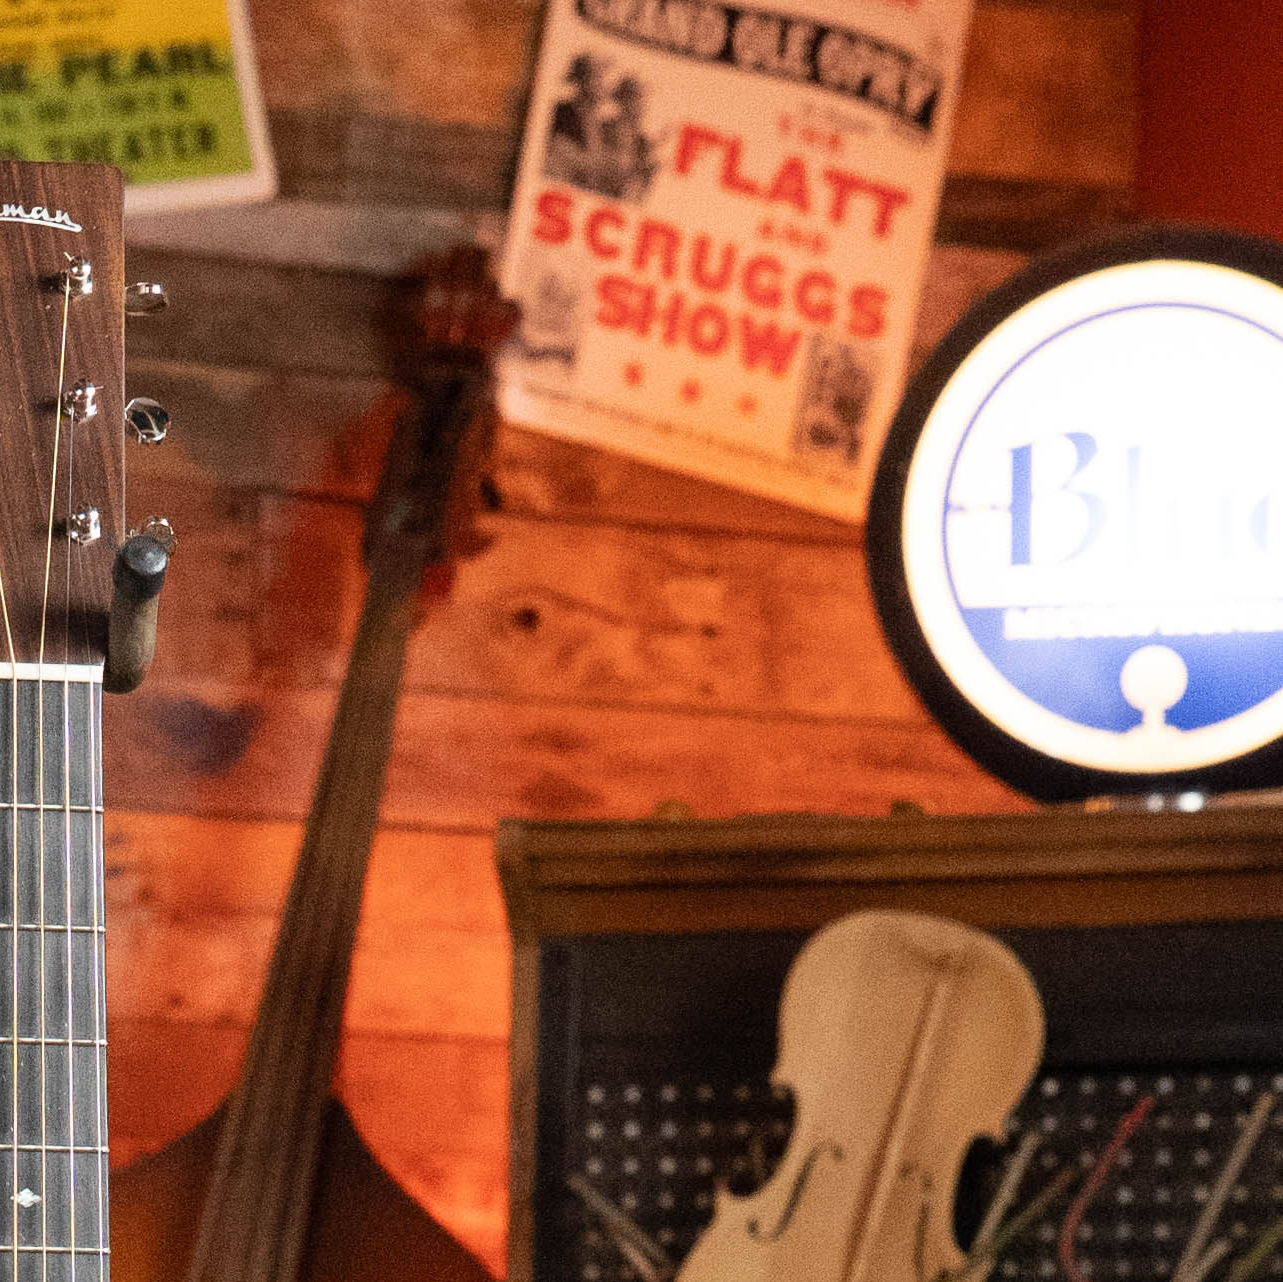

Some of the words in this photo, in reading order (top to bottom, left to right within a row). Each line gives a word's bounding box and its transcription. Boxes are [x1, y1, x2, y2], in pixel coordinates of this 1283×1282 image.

[59, 41, 234, 88] PEARL
[673, 122, 911, 238] FLATT
[532, 190, 889, 340] SCRUGGS
[595, 274, 803, 377] SHOW
